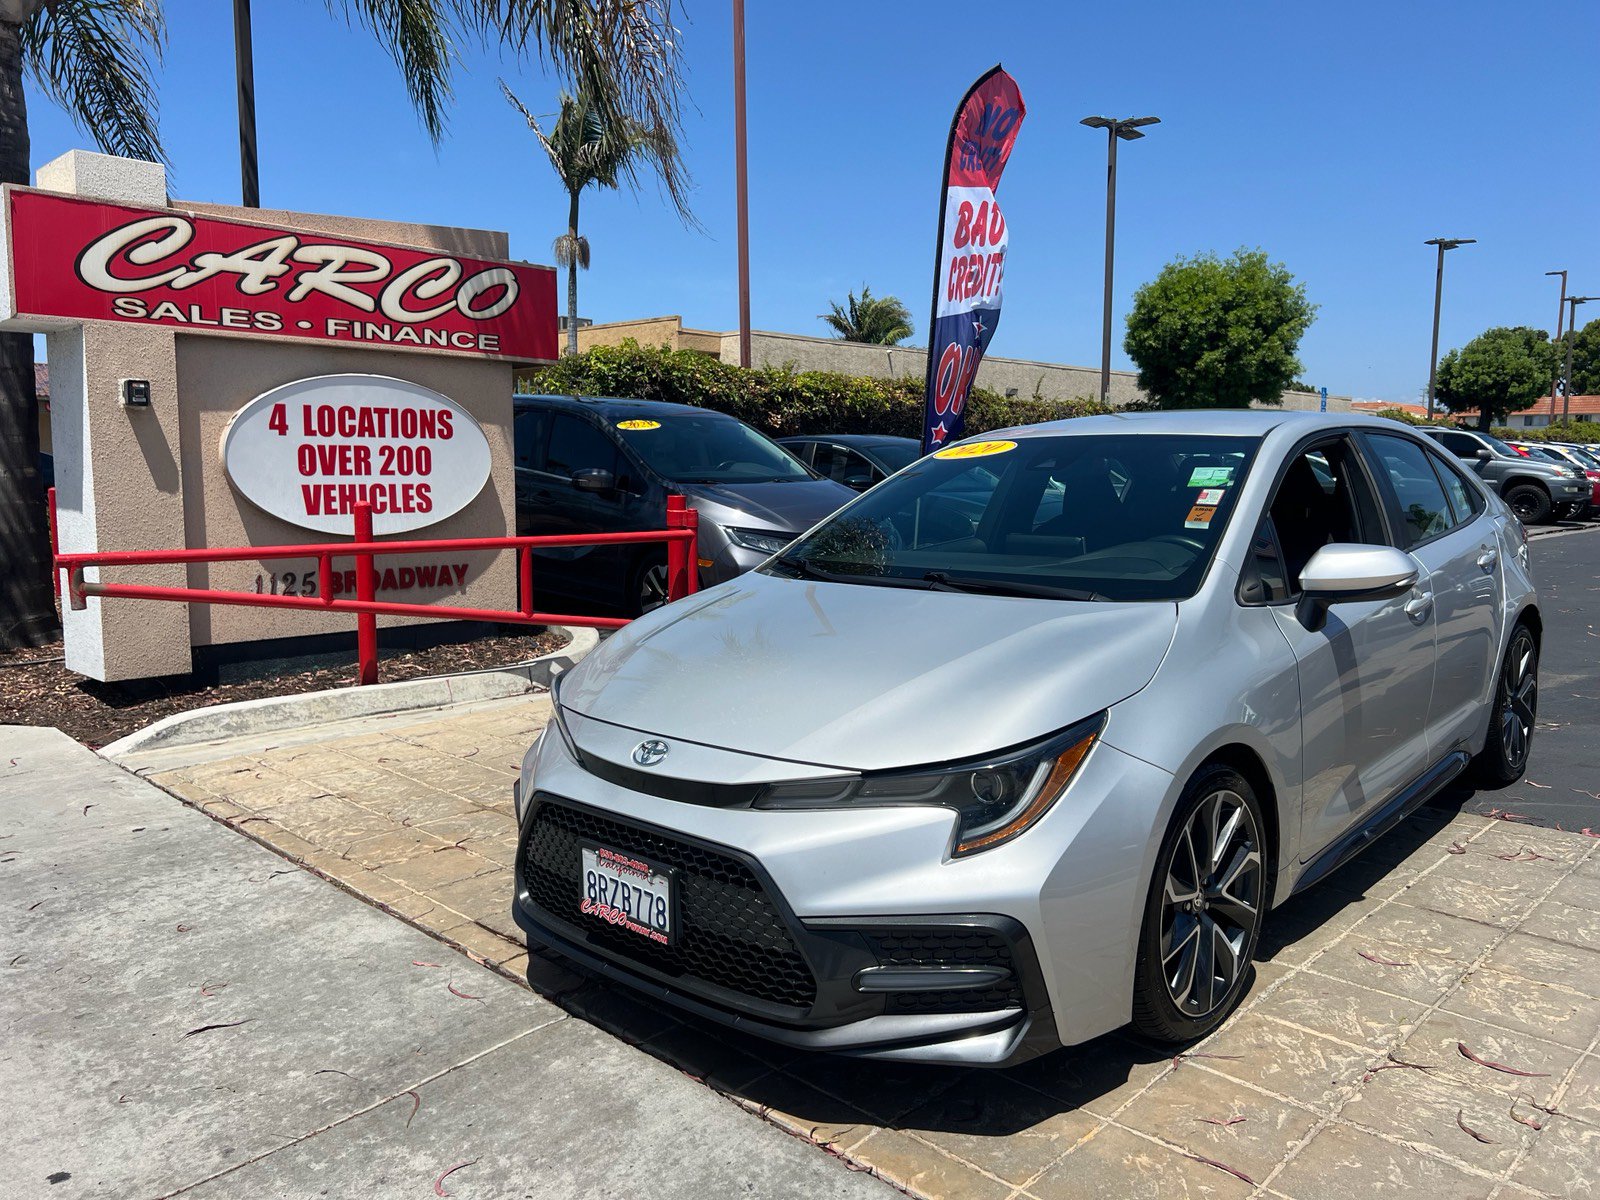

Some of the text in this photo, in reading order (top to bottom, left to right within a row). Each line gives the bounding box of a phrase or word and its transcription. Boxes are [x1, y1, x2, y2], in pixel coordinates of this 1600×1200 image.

[975, 102, 1020, 141] NO
[954, 201, 1005, 249] BAD
[74, 215, 520, 324] CARCO
[112, 297, 501, 352] SALES FINANCE
[269, 403, 454, 440] 4 LOCATIONS
[298, 444, 432, 476] OVER 200
[302, 483, 433, 516] VEHICLES
[255, 571, 317, 597] 1125
[586, 870, 667, 930] 8RZB778
